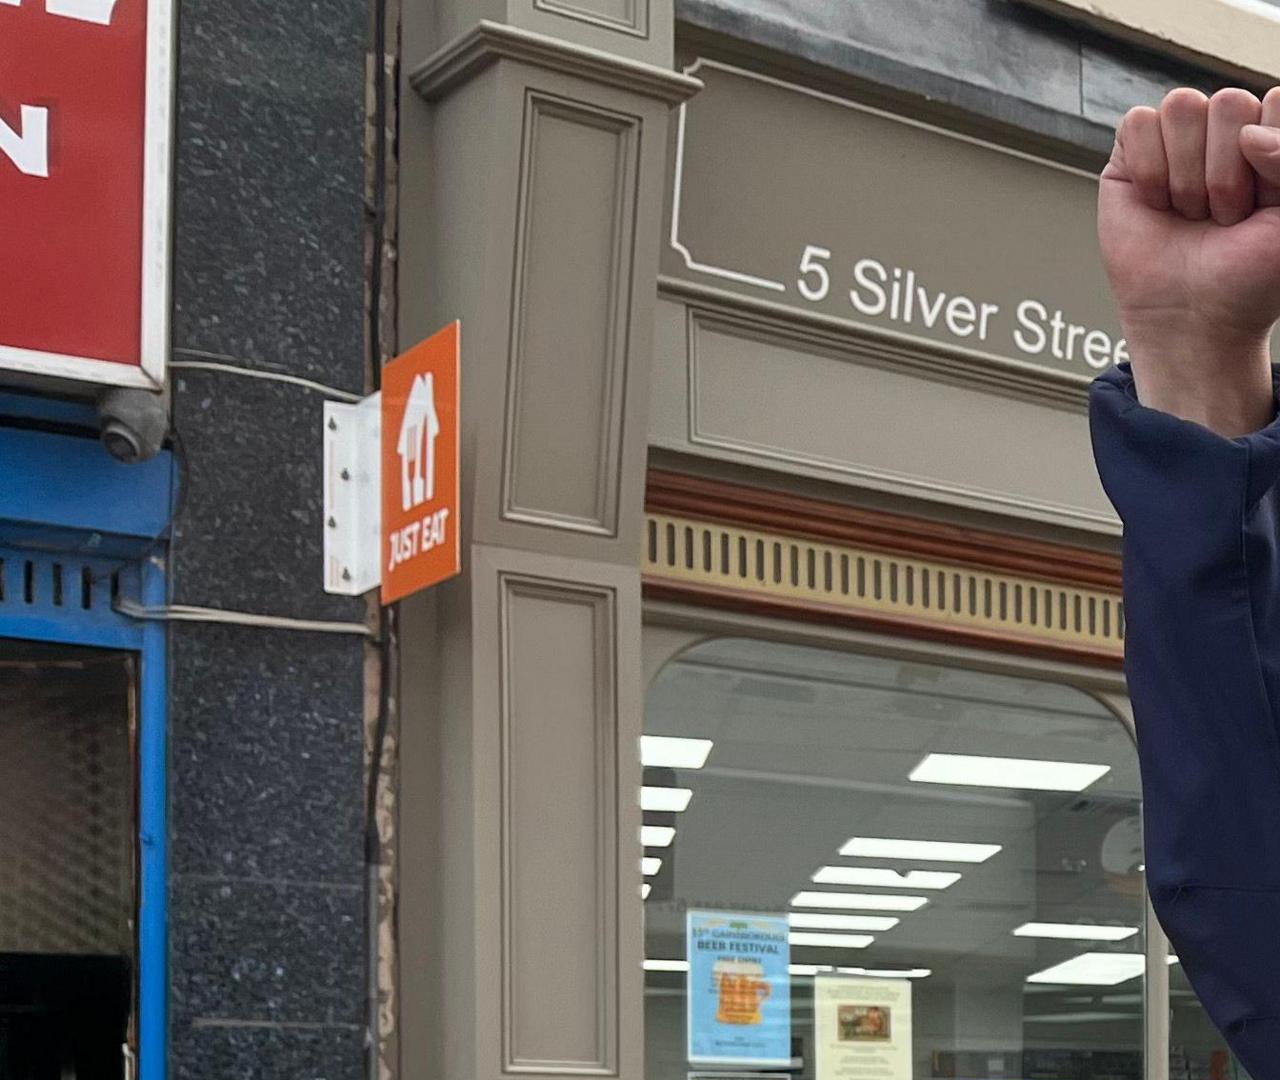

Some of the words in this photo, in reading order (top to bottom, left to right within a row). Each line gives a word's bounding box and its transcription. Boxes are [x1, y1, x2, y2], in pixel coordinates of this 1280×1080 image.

[796, 245, 831, 301] 5
[849, 258, 999, 341] Silver
[1012, 299, 1130, 368] Stree
[388, 520, 420, 573] JUST
[422, 507, 448, 552] EAT
[697, 941, 726, 952] BEER
[729, 942, 779, 955] FESTIVAL
